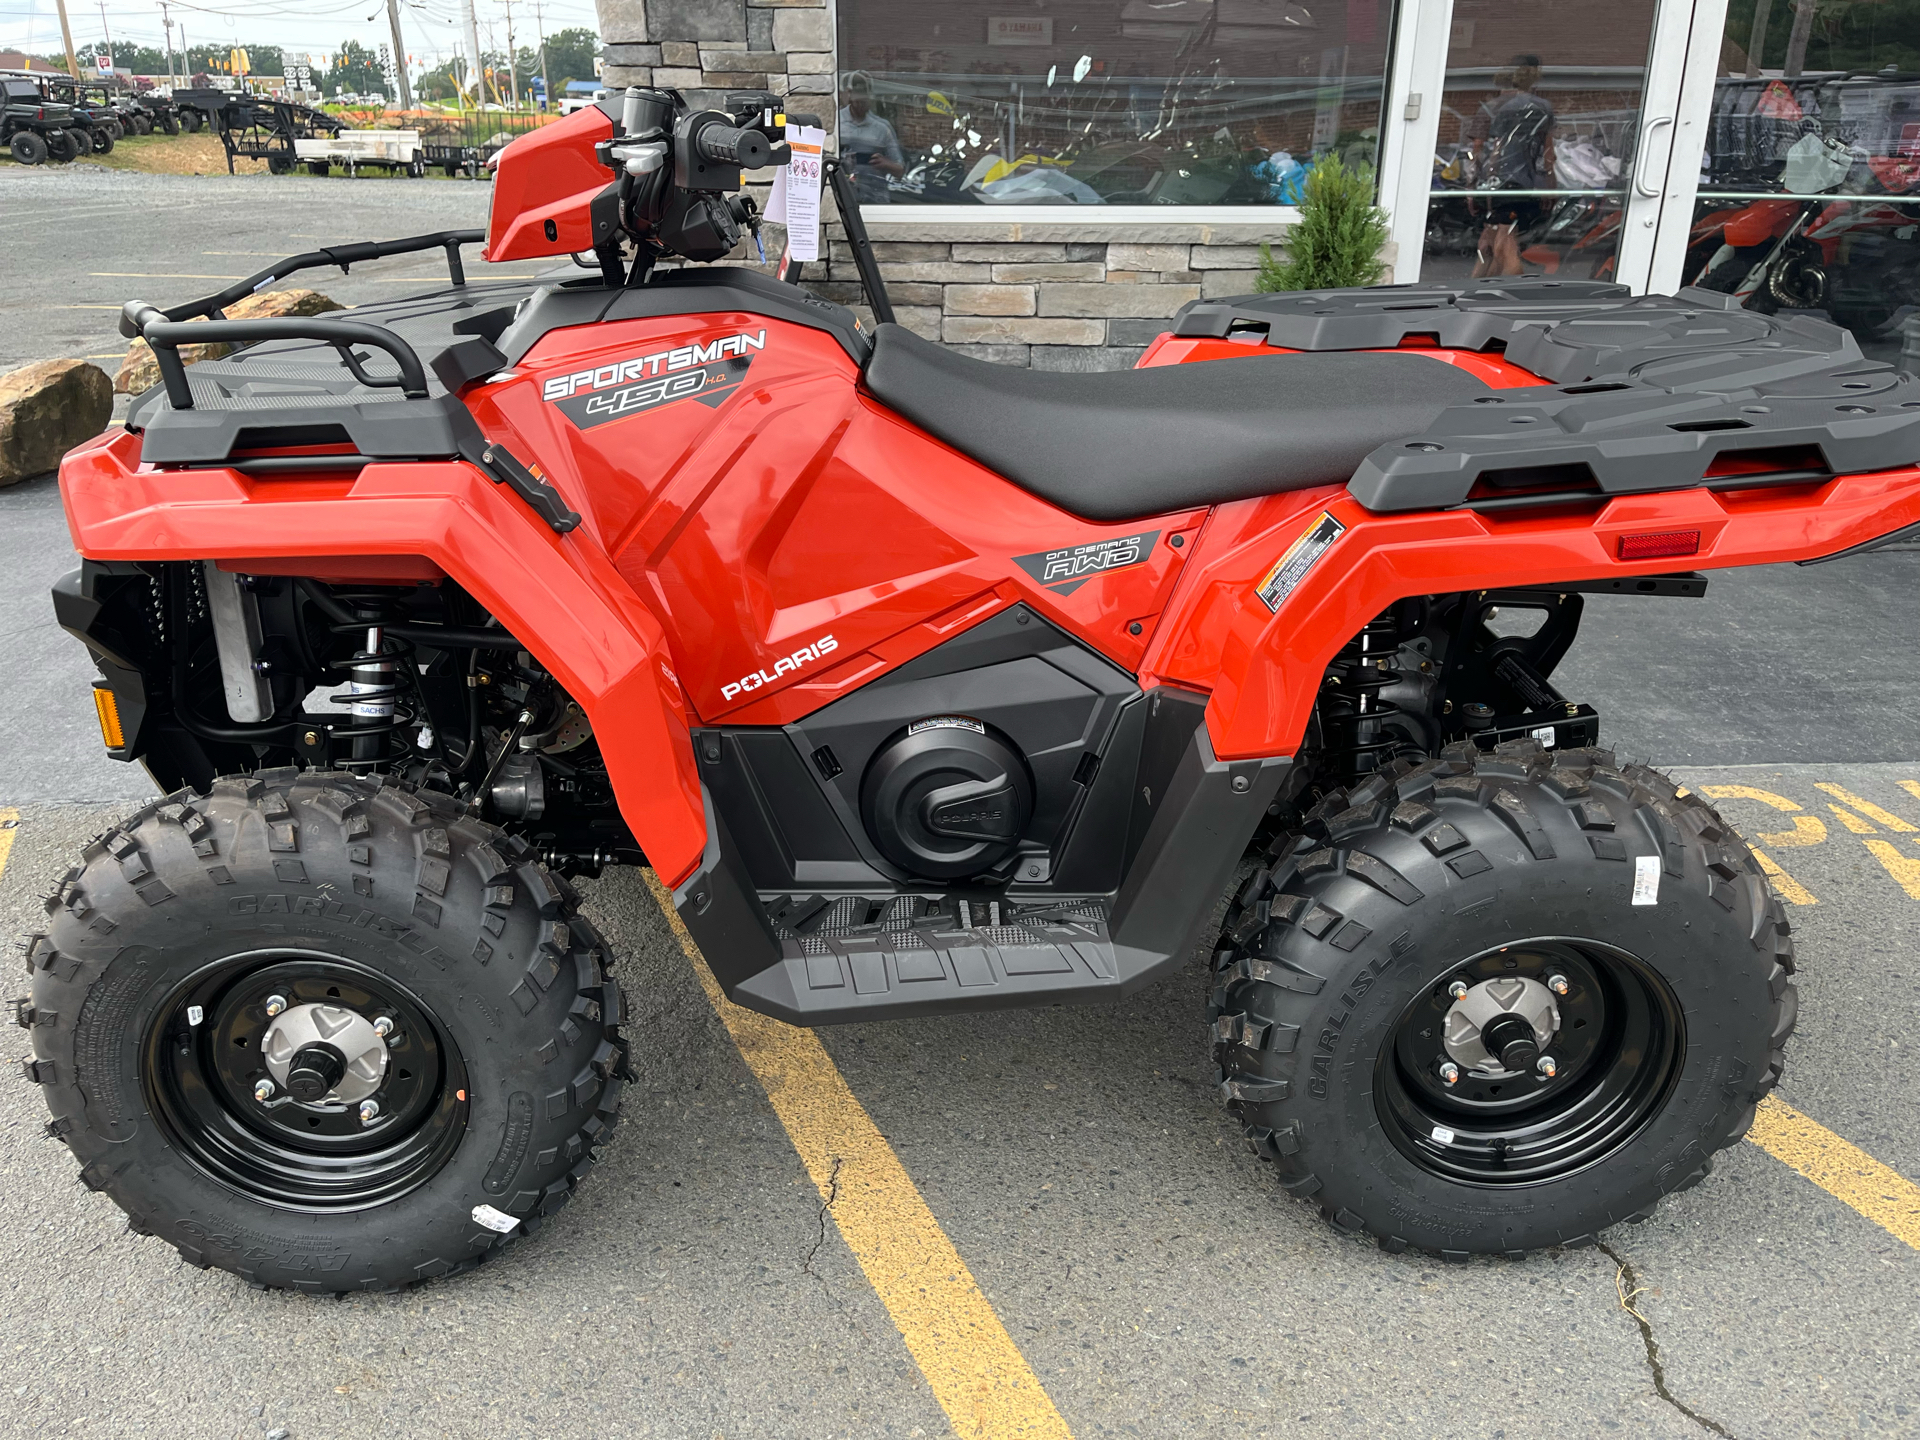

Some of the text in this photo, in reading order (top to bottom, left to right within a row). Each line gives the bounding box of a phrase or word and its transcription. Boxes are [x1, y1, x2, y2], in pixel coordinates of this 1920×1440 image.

[542, 329, 767, 402] SPORTSMAN
[586, 368, 727, 415] 450 H.O.
[1043, 545, 1140, 580] AWD
[1046, 536, 1141, 561] ON DEMAND
[1279, 531, 1311, 565] WARNING
[720, 633, 839, 702] POLARIS
[360, 706, 386, 715] SACHS
[940, 808, 1003, 824] POLARIS
[228, 894, 458, 972] CARLISLE
[1308, 929, 1418, 1101] CARLISLE
[498, 1122, 516, 1165] TUBELESS
